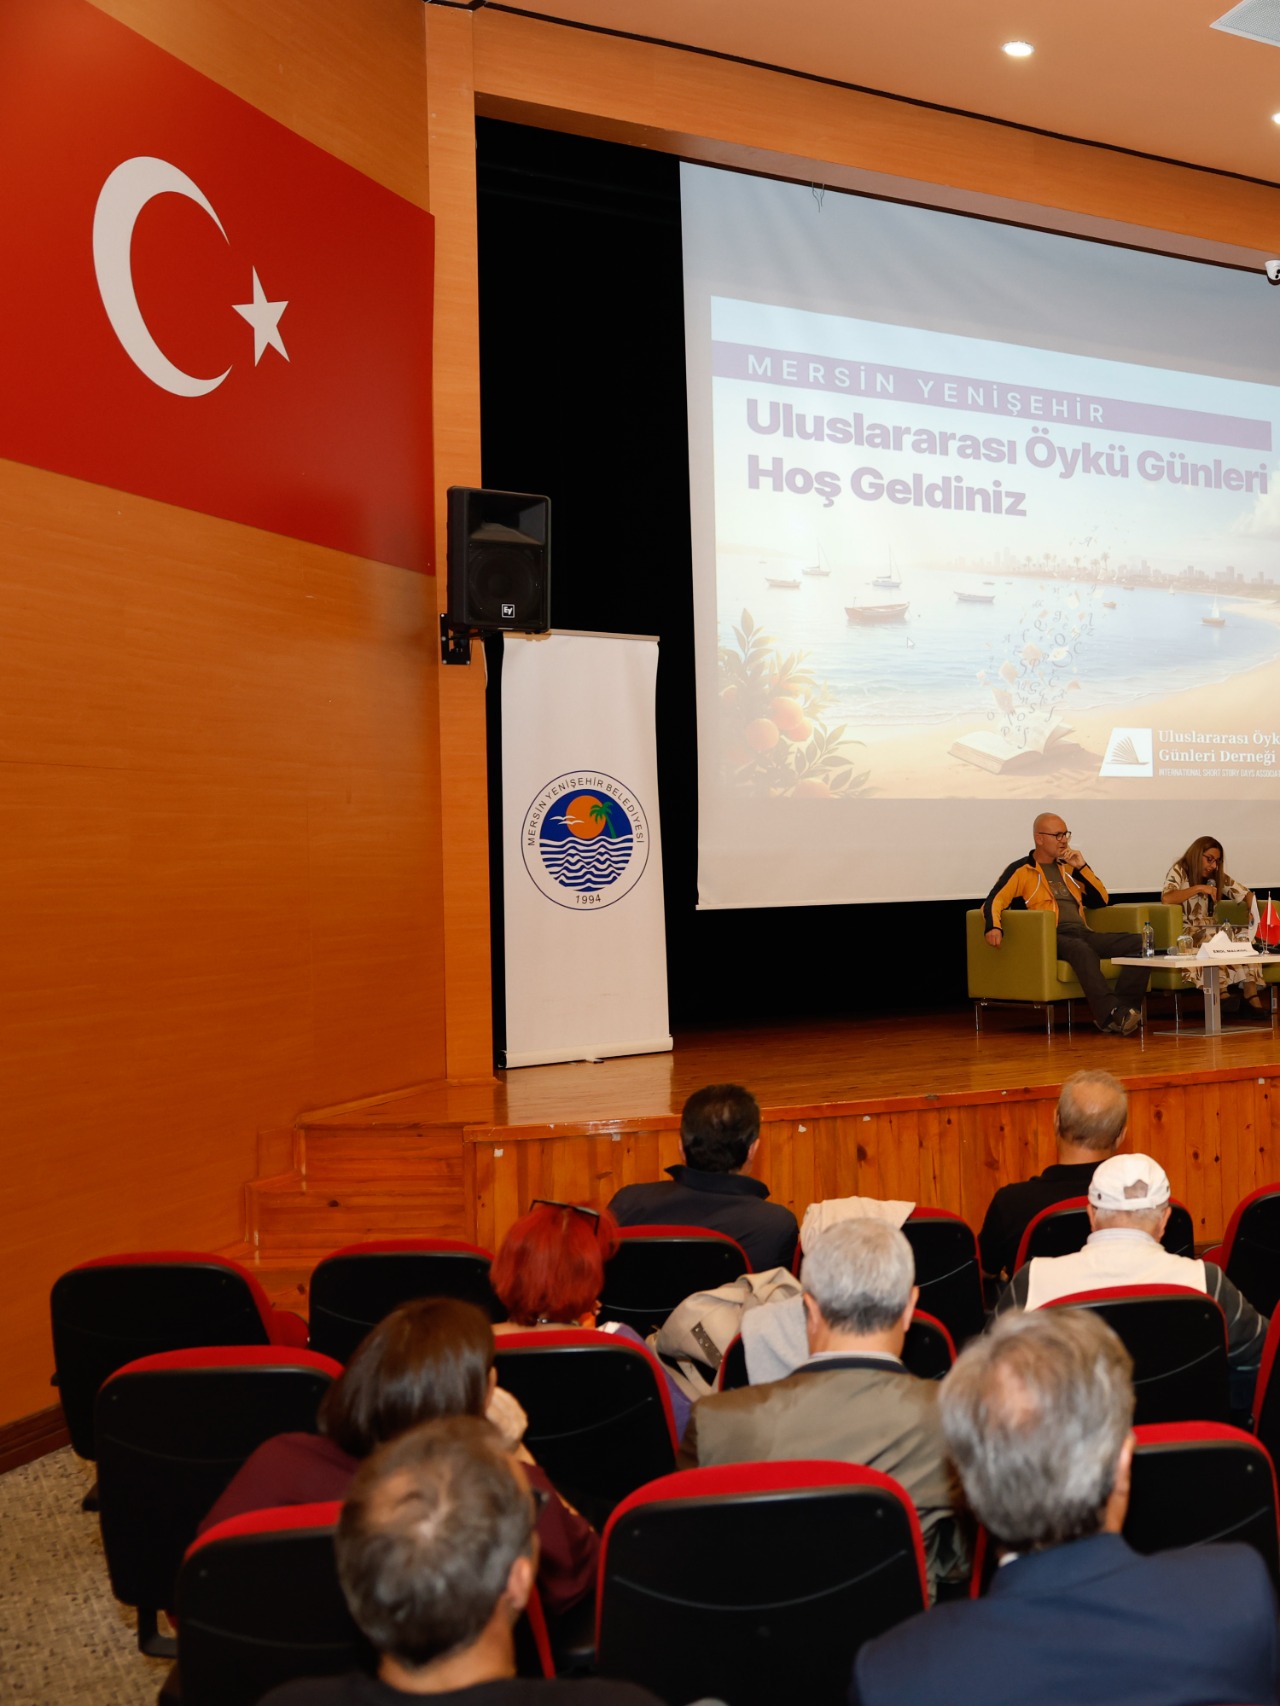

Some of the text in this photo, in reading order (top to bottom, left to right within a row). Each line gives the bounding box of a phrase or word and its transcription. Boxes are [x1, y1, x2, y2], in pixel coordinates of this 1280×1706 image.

[747, 353, 1104, 424] MERSİN YENİŞEHİR
[746, 397, 1269, 495] Uluslararası Öykü Günleri
[747, 453, 1027, 517] Hoş Geldiniz
[1158, 730, 1249, 745] Uluslararası
[1158, 748, 1276, 766] Günleri Derneği
[528, 801, 547, 846] MERSİN
[545, 777, 603, 800] YENİŞEHİR
[575, 894, 602, 904] 1994
